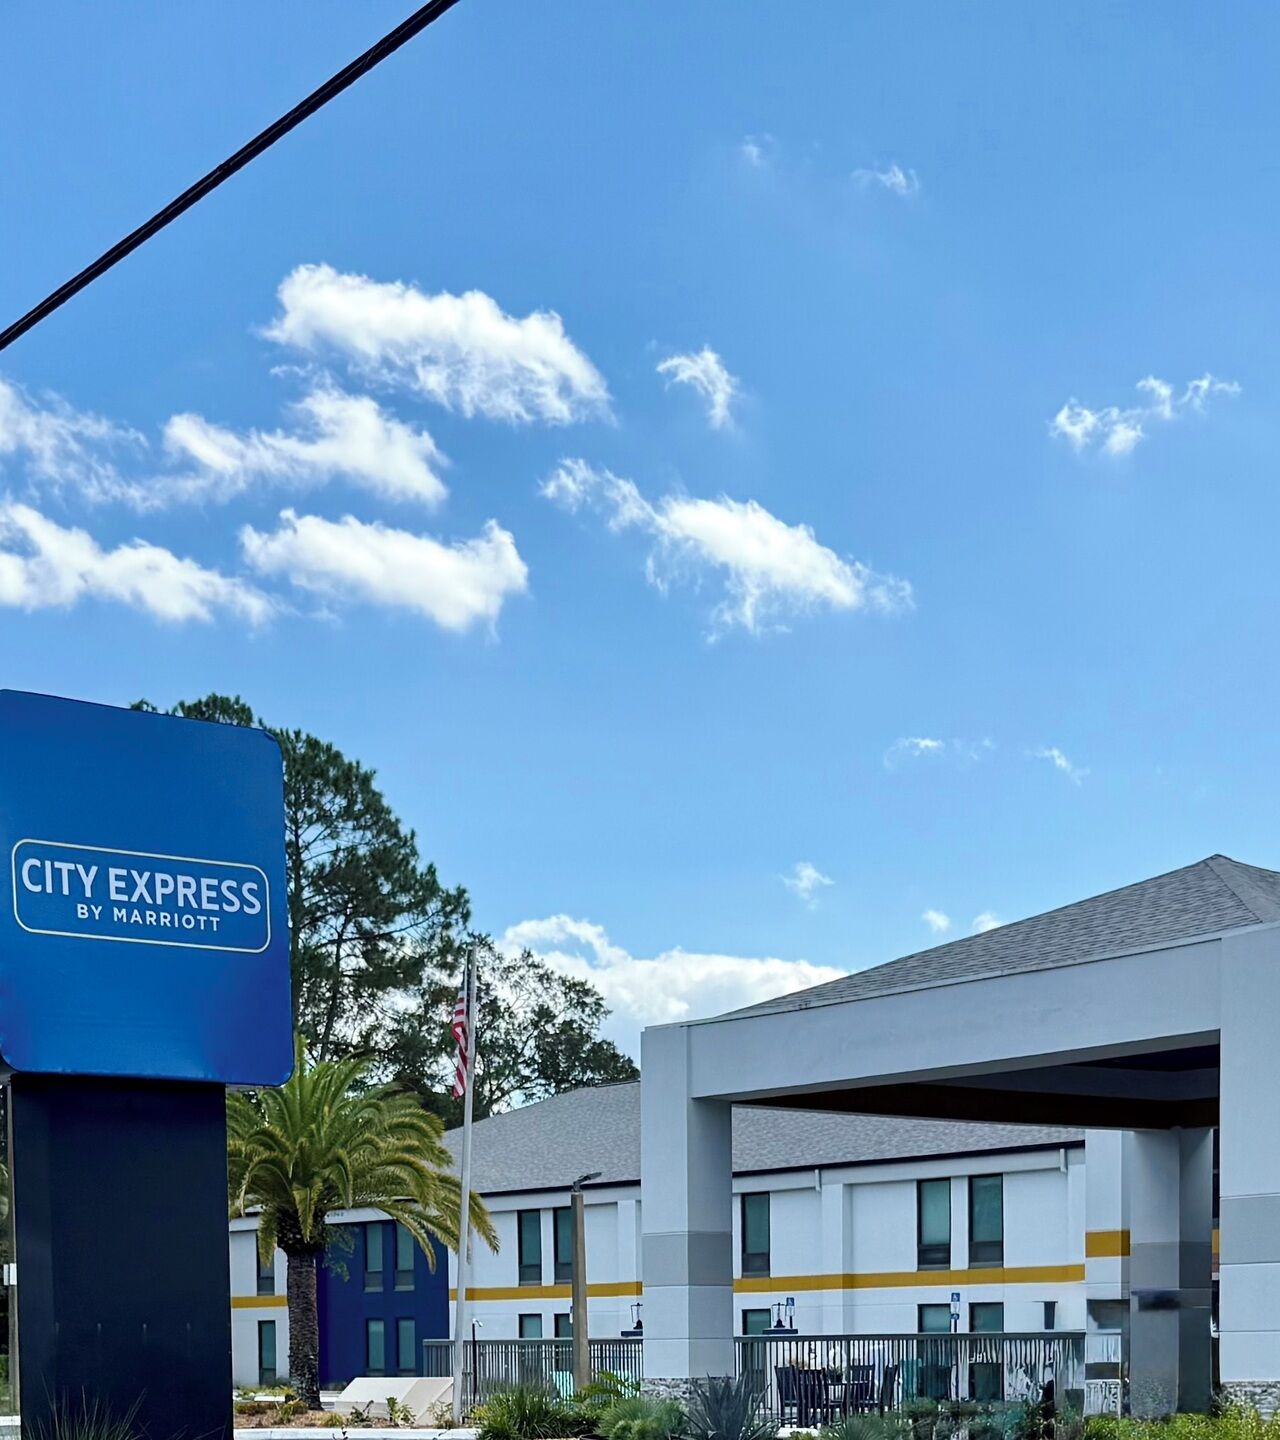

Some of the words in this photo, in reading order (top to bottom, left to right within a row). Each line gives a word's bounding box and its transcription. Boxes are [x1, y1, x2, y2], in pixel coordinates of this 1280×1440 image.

[21, 858, 99, 898] CITY
[108, 867, 262, 915] EXPRESS
[77, 903, 102, 921] BY
[113, 907, 221, 932] MARRIOTT
